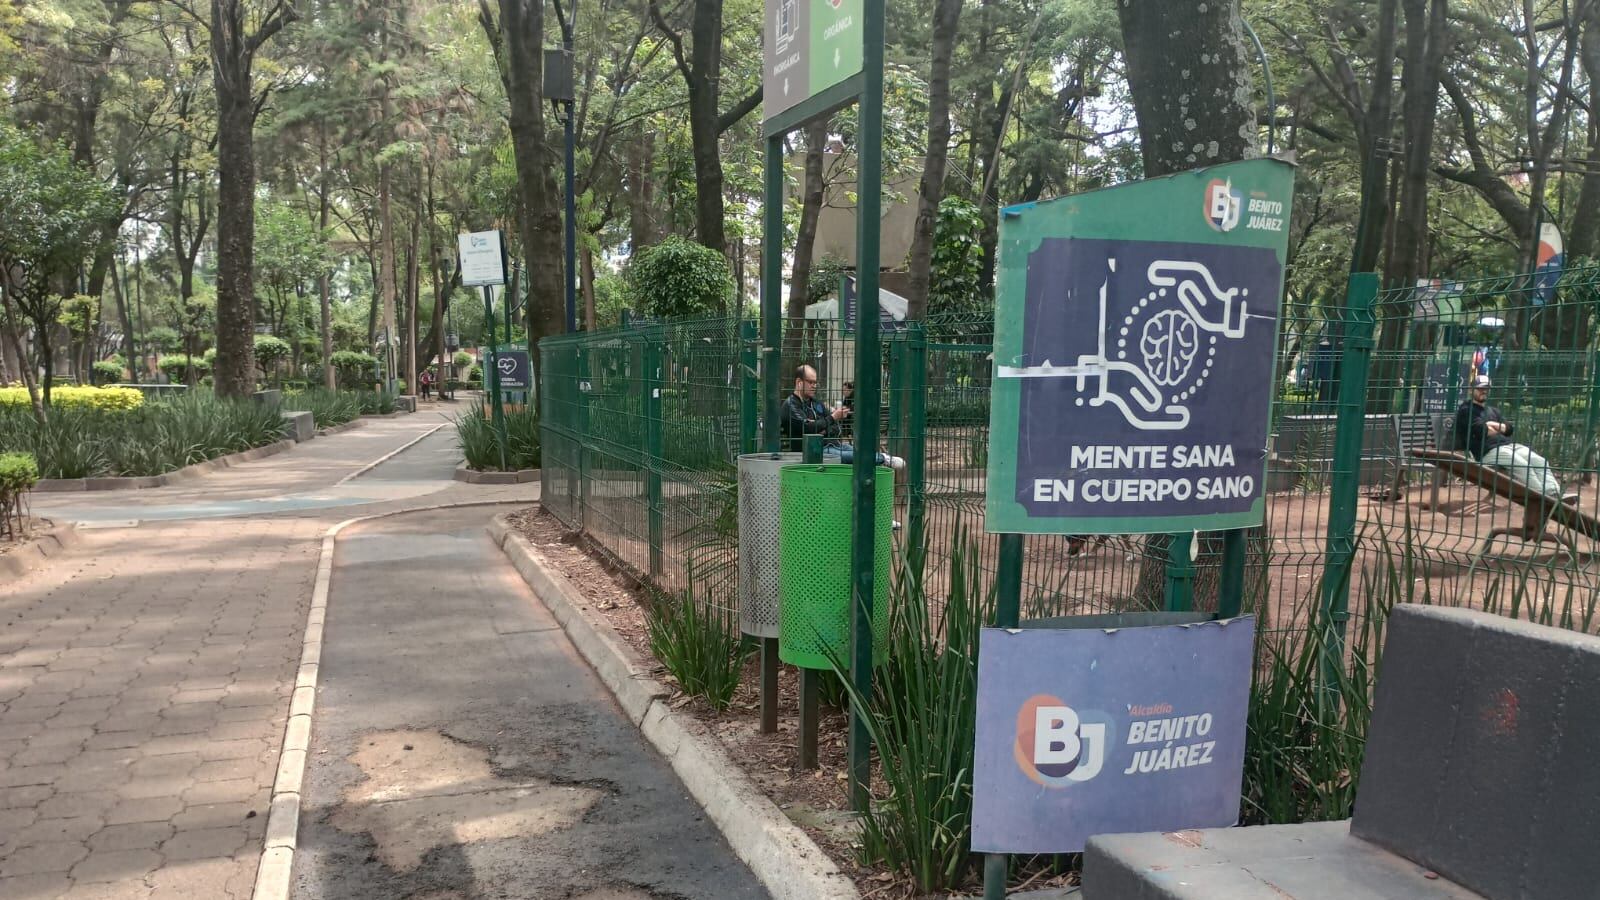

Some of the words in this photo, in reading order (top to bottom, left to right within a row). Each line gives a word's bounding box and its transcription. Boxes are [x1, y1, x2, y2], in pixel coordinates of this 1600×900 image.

[823, 15, 852, 41] ORGÁNICA
[773, 51, 800, 76] INORGÁNICA
[1248, 199, 1282, 214] BENITO
[1246, 214, 1284, 231] JUÁREZ
[1070, 445, 1168, 469] MENTE
[1171, 444, 1235, 468] SANA
[1033, 479, 1074, 502] EN
[1081, 477, 1192, 502] CUERPO
[1195, 475, 1254, 500] SANO
[1127, 712, 1213, 745] BENITO
[1124, 740, 1216, 775] JUÁREZ
